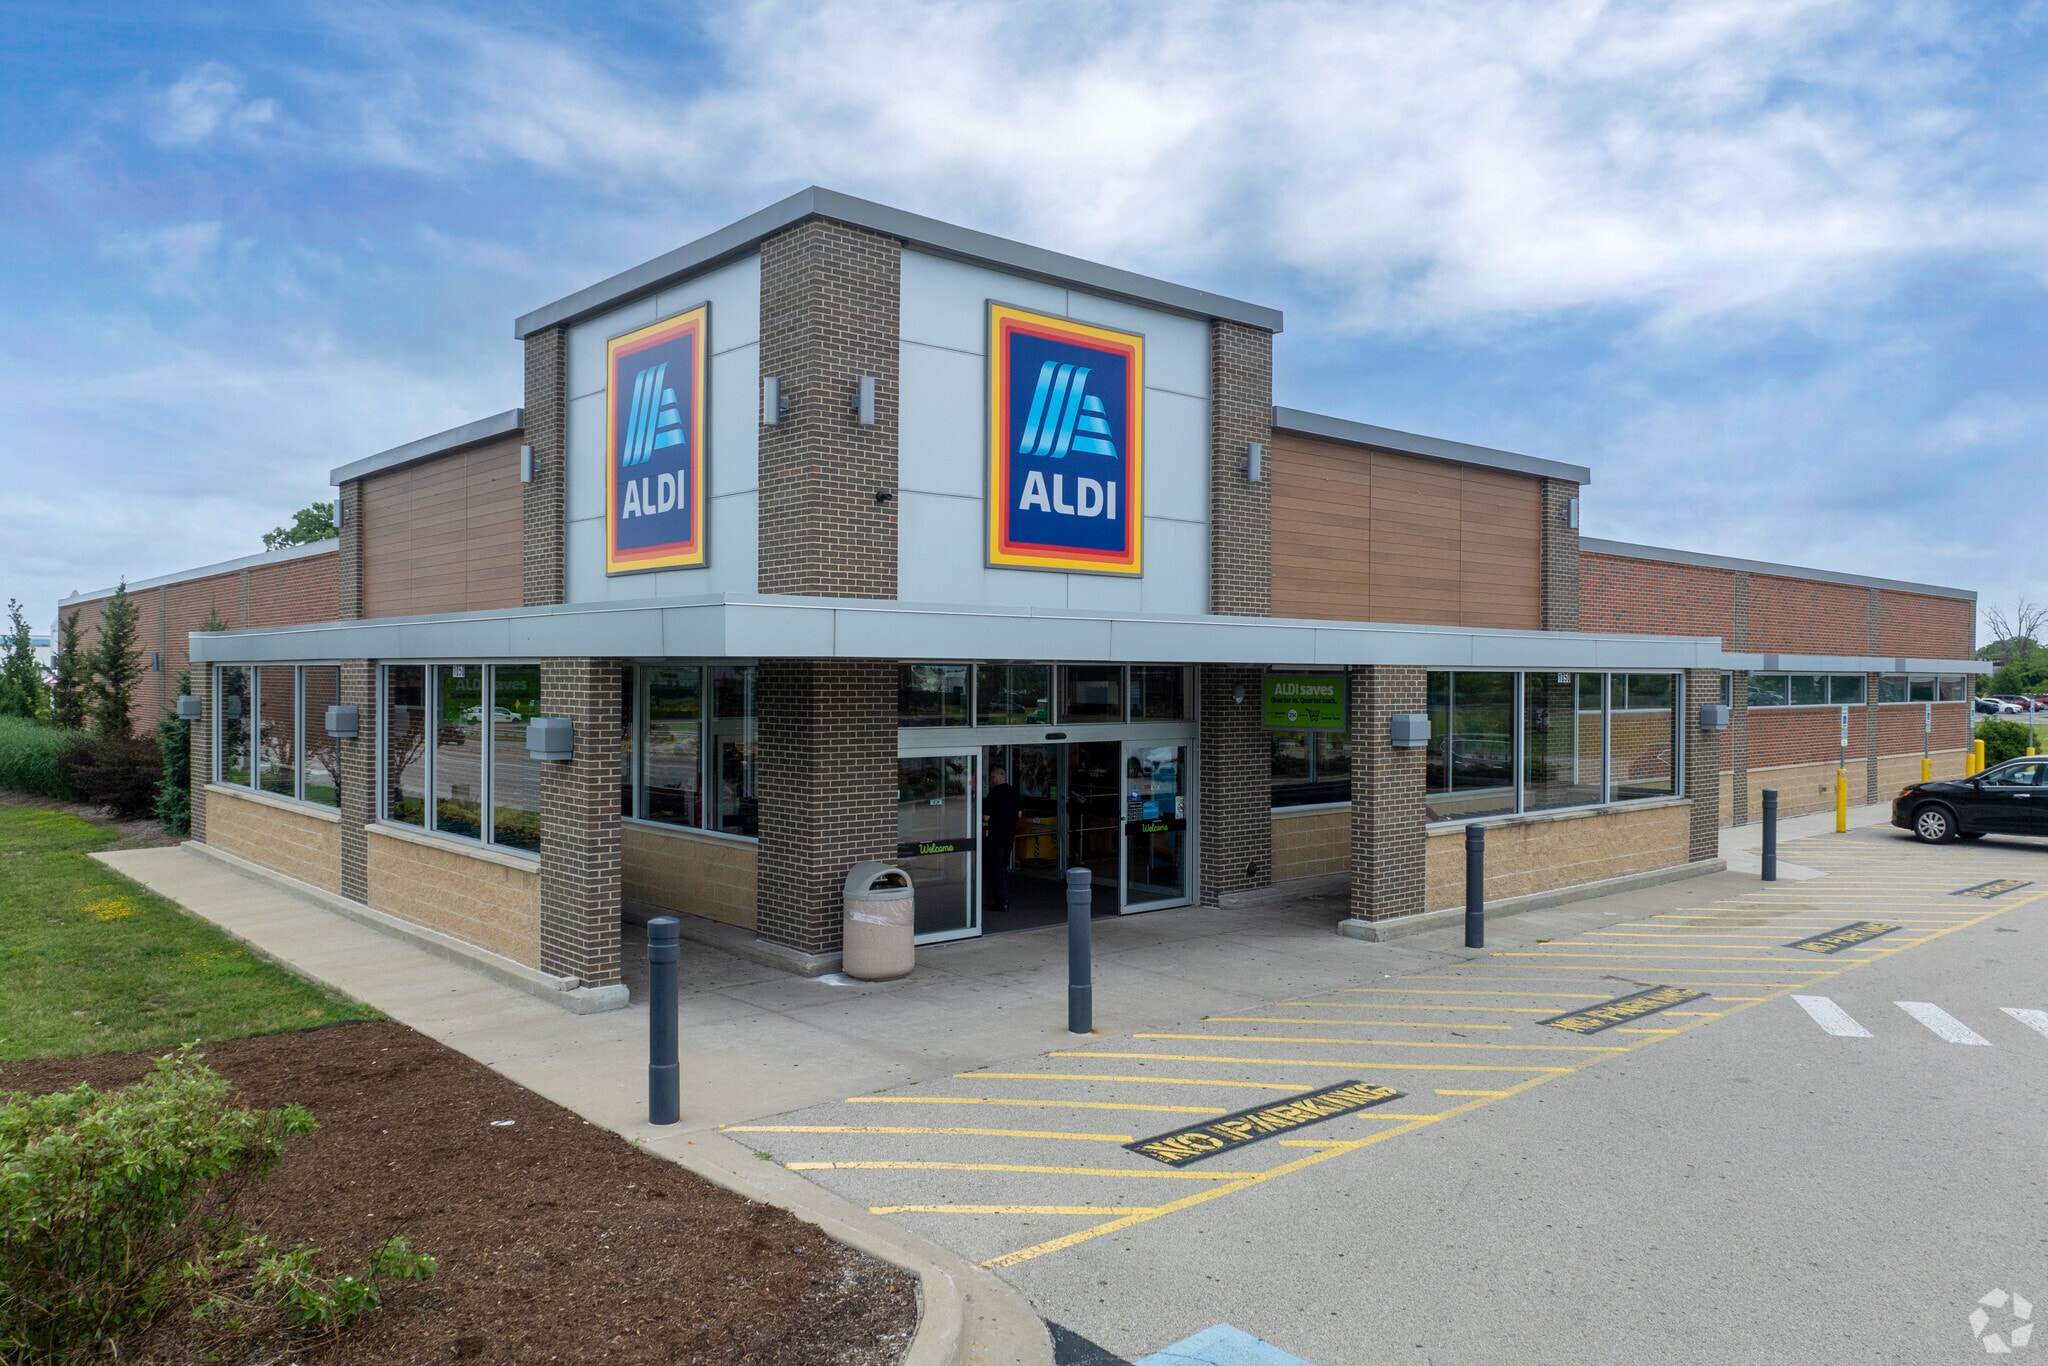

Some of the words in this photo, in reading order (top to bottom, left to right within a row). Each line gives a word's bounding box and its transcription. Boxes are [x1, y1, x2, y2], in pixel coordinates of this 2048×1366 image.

[623, 469, 684, 519] ALDI
[1019, 470, 1117, 520] ALDI
[455, 679, 481, 691] ALD
[495, 680, 528, 691] aves
[1274, 683, 1299, 695] ALDI
[1300, 685, 1334, 696] saves
[1141, 823, 1169, 833] Welcome
[919, 843, 954, 855] Welcome
[1139, 1132, 1224, 1163] NO
[1206, 1082, 1398, 1141] PARKING
